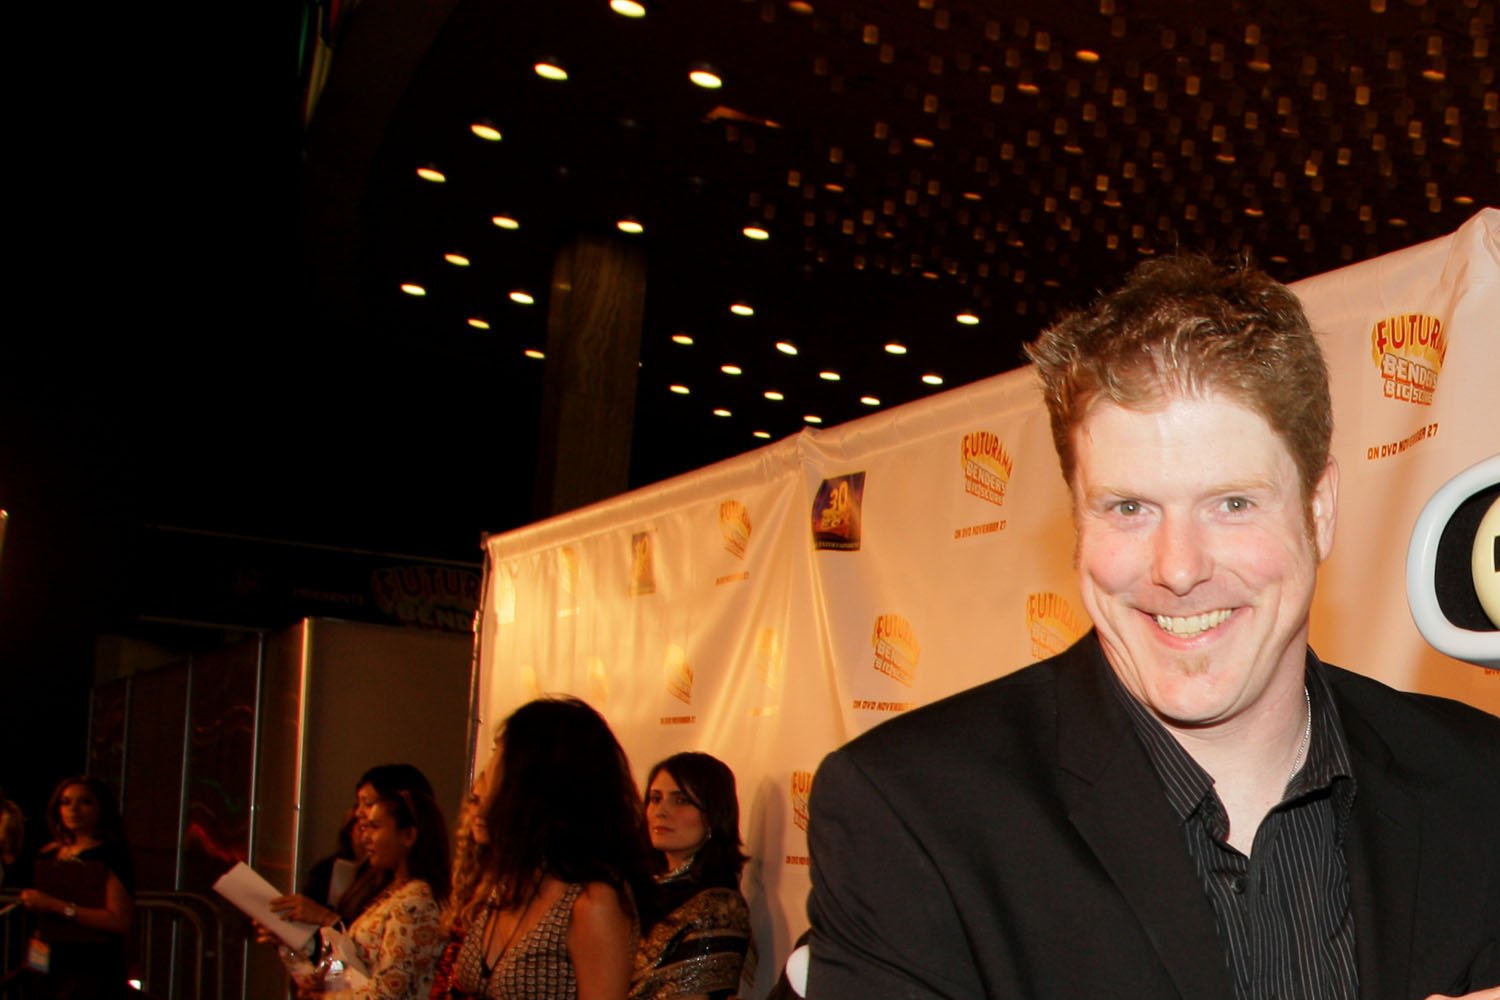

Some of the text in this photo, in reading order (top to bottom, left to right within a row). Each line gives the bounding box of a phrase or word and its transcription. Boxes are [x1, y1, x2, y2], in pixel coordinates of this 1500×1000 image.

[1384, 380, 1410, 402] BIG
[1368, 447, 1379, 460] ON
[1381, 442, 1398, 458] DVD
[1427, 422, 1439, 438] 27
